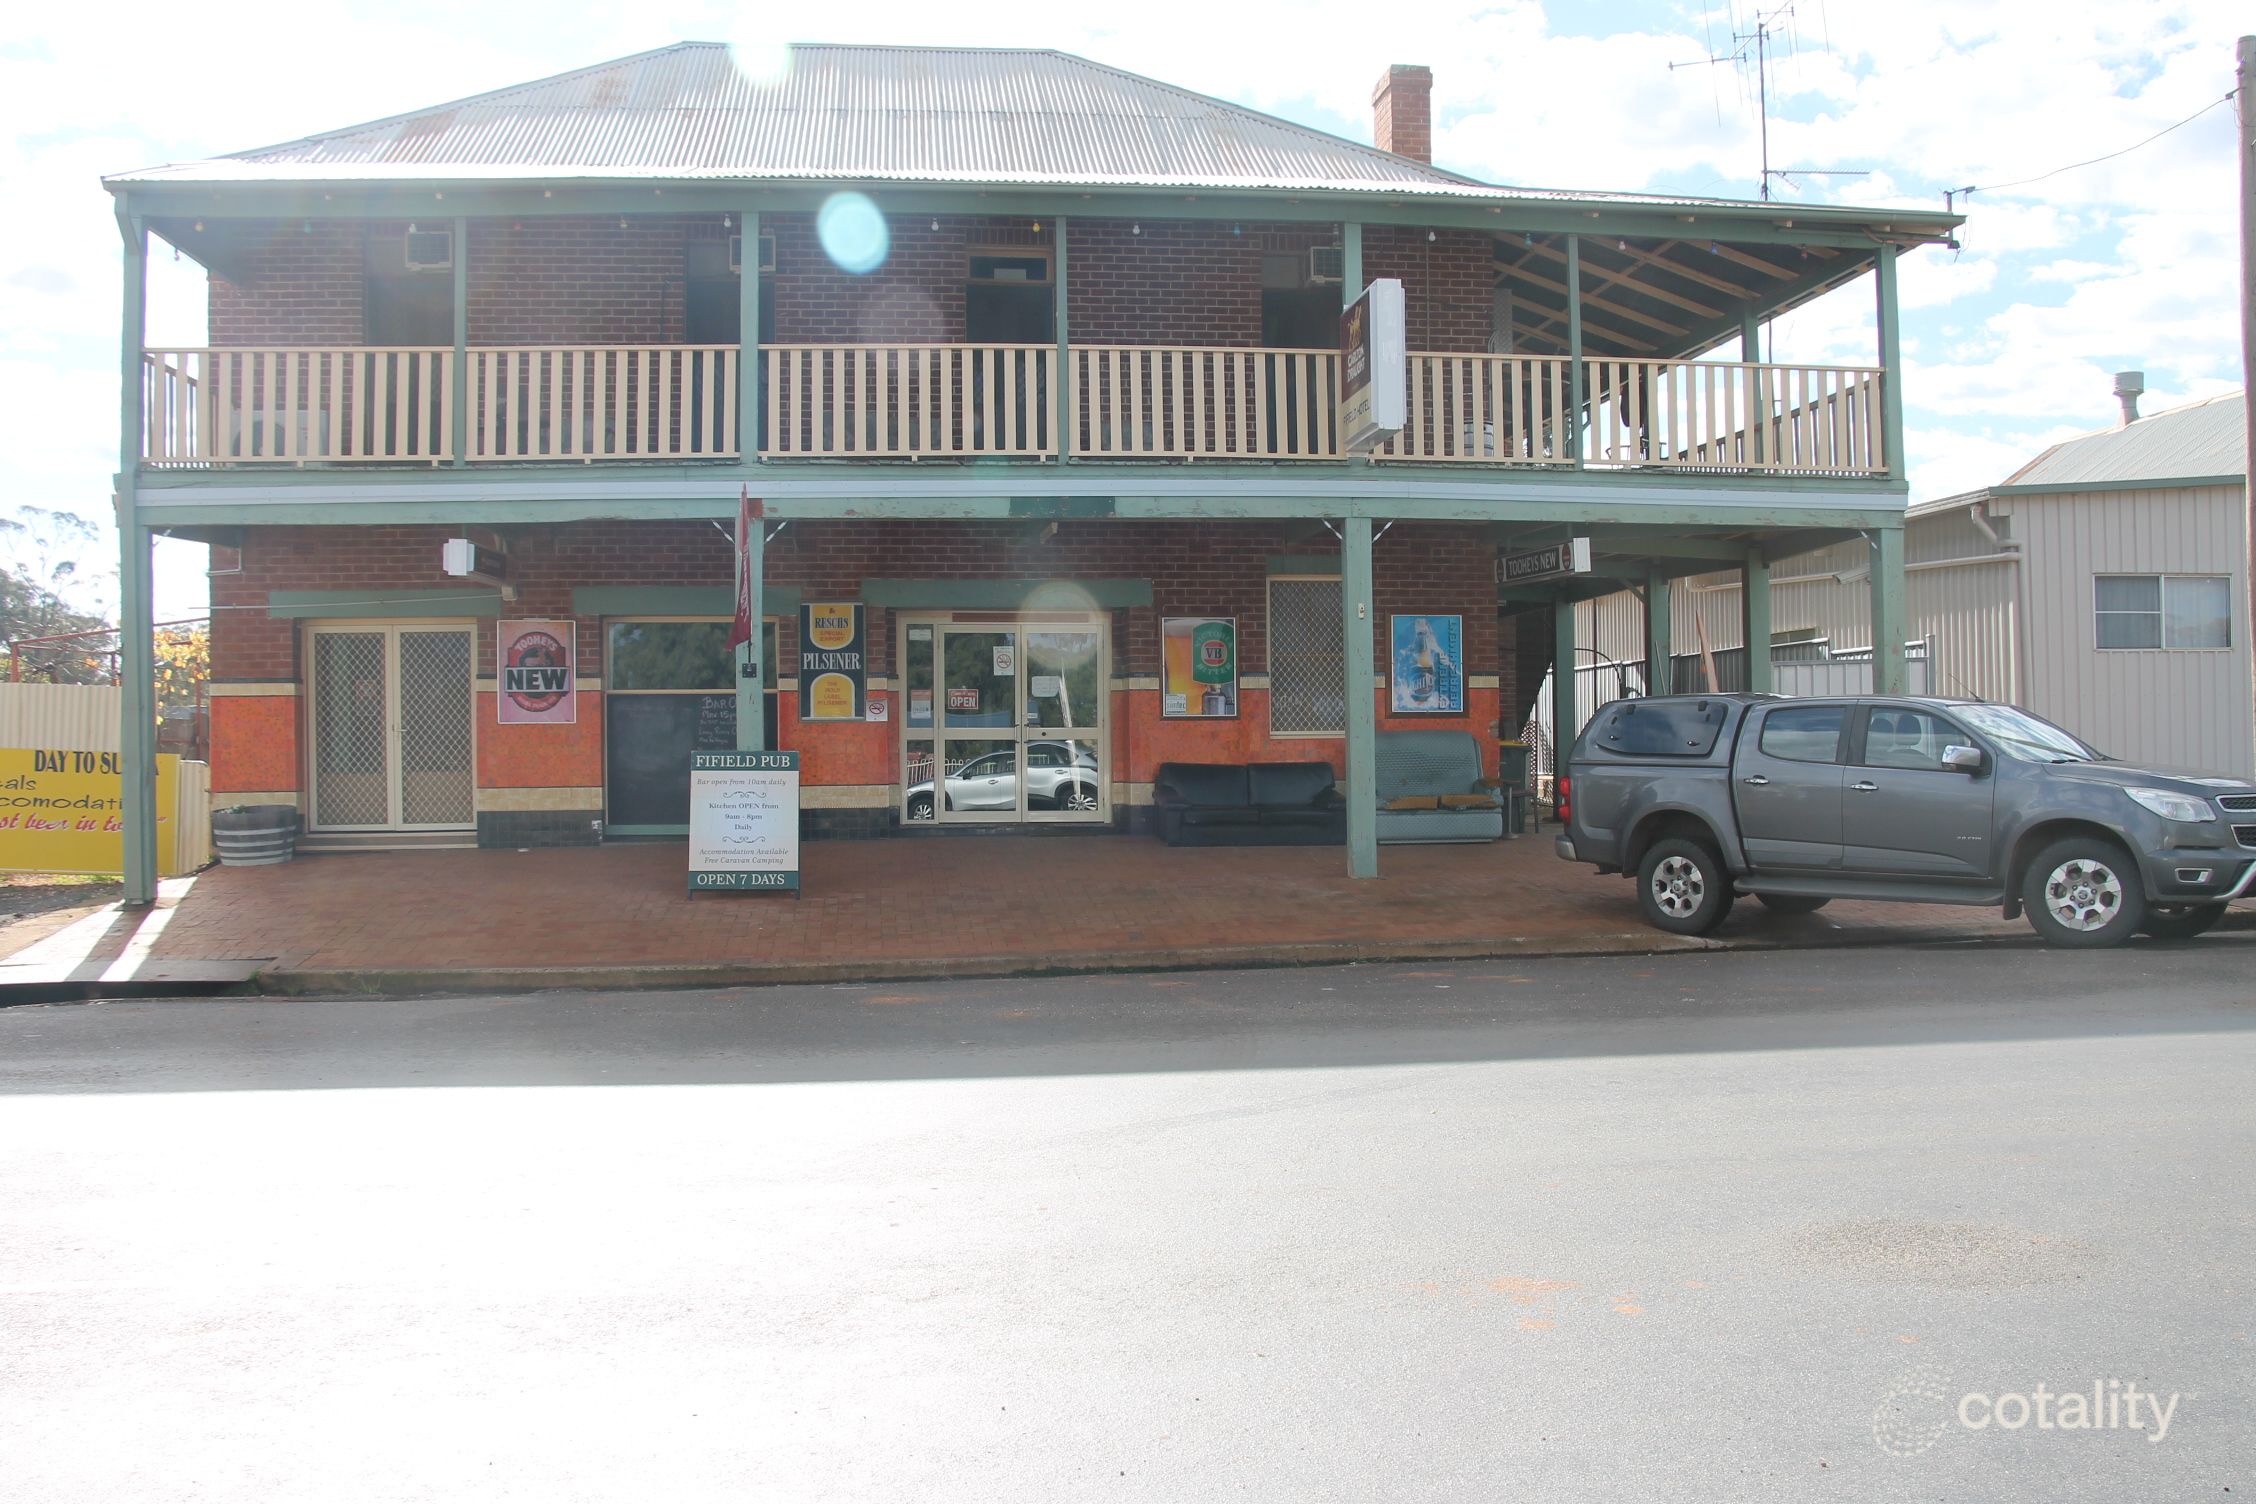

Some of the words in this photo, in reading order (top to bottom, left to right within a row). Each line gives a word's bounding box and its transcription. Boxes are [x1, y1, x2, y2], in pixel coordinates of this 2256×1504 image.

[1508, 555, 1539, 576] TOOHEYS
[1540, 551, 1556, 569] NEW
[815, 617, 849, 629] RESCHS
[514, 635, 558, 652] TOOHEYS
[1205, 647, 1222, 659] VB
[802, 652, 860, 670] PILSENER
[506, 668, 569, 691] NEW
[950, 696, 976, 707] OPEN
[34, 750, 68, 773] DAY
[73, 751, 96, 774] TO
[695, 755, 757, 768] FIFIELD
[760, 755, 791, 768] PUB
[729, 778, 745, 787] from
[768, 778, 787, 787] daily
[0, 795, 123, 810] comodati
[75, 815, 98, 831] in
[746, 814, 763, 822] 8pm
[734, 823, 753, 832] Daily
[699, 848, 755, 856] Accommodation
[756, 848, 789, 856] Available
[752, 857, 784, 865] Camping
[697, 873, 736, 885] OPEN
[740, 873, 747, 885] 7
[751, 873, 785, 885] DAYS
